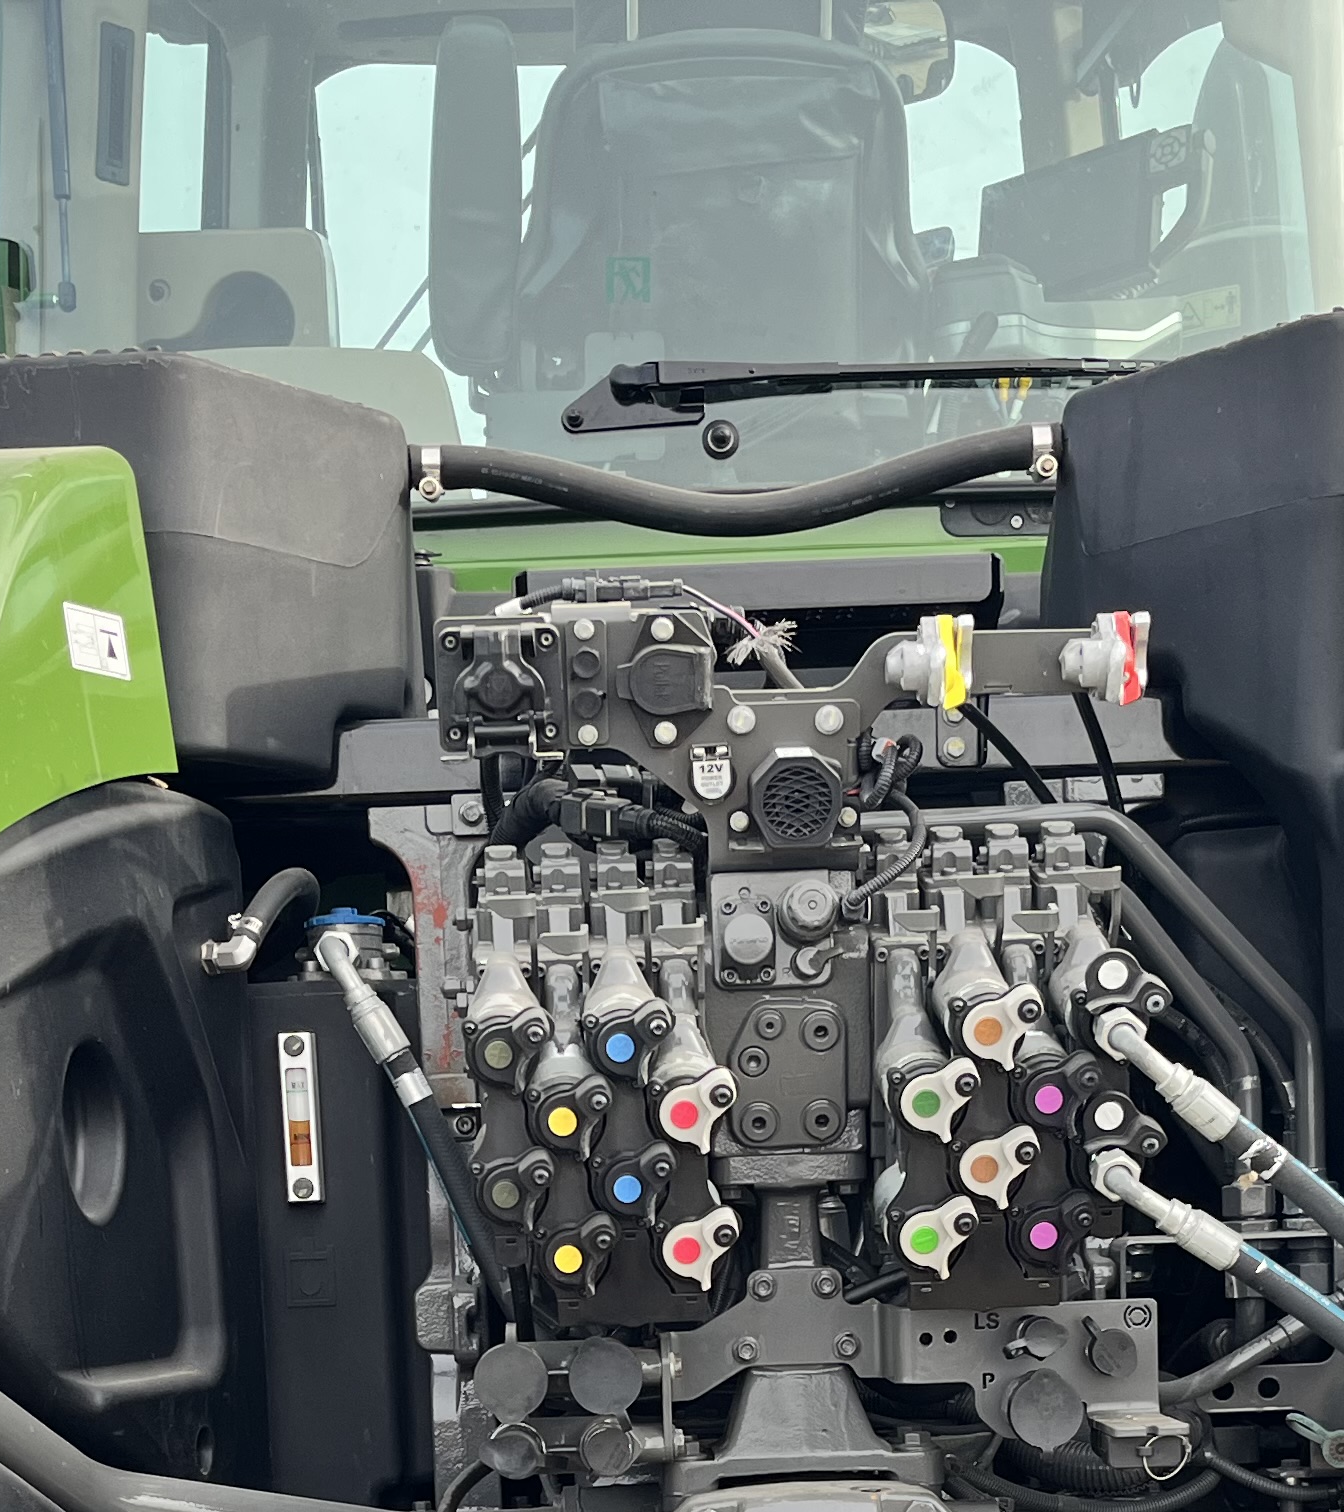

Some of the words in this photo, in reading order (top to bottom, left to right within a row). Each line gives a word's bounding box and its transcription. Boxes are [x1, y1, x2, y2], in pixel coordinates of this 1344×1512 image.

[699, 763, 724, 774] 12V
[974, 1312, 1000, 1330] LS
[982, 1372, 995, 1390] P
